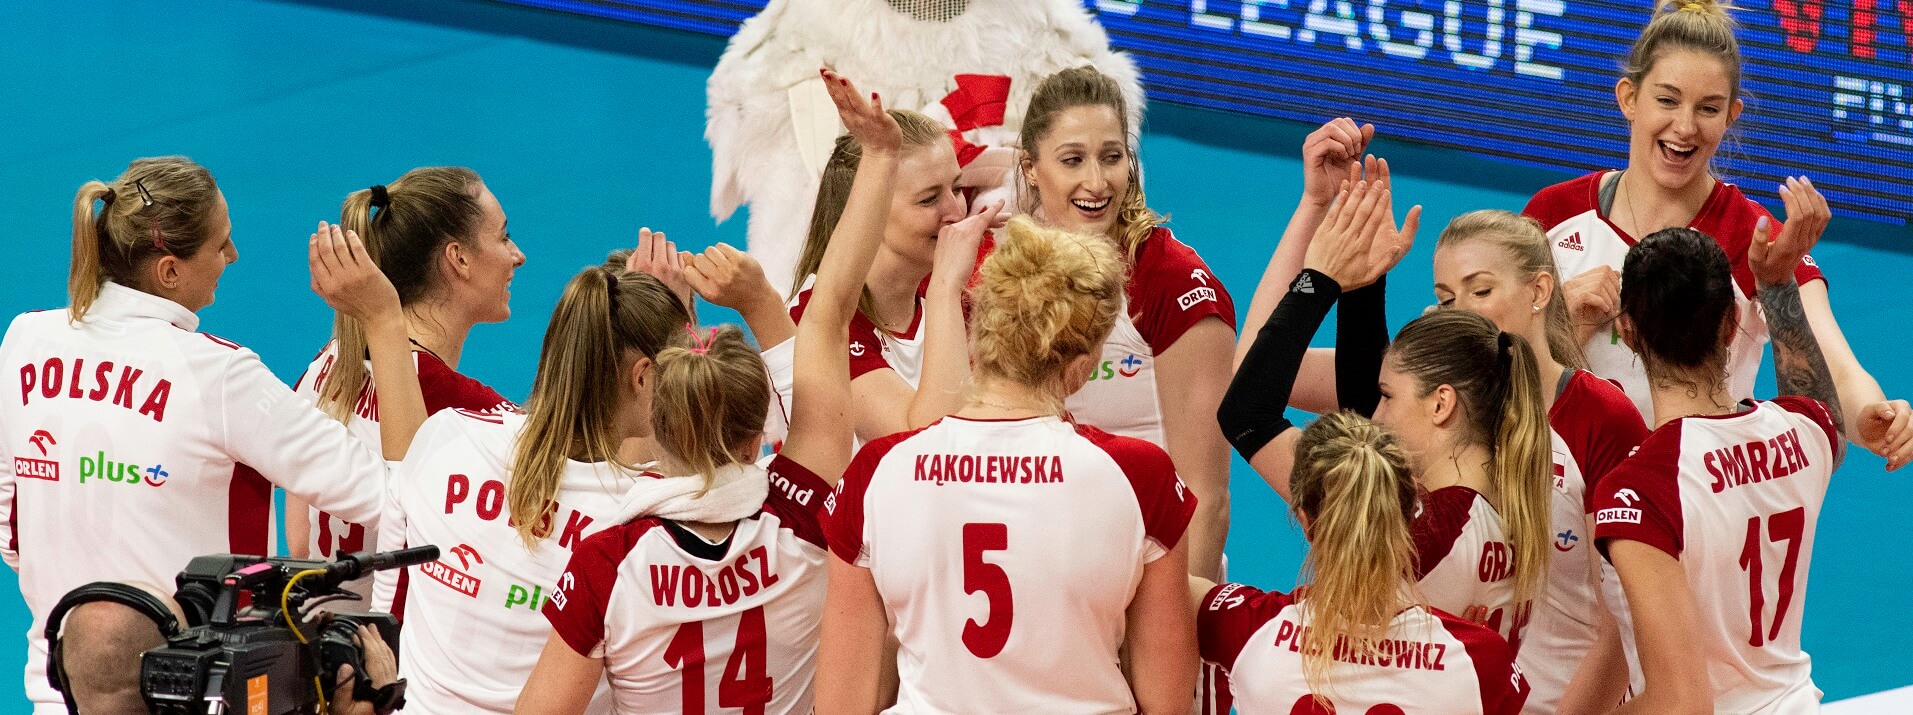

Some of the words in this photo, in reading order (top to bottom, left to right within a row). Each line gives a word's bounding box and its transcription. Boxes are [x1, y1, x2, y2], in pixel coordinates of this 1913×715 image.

[1558, 240, 1585, 252] adidas
[1181, 288, 1215, 307] ORLEN
[20, 357, 172, 423] POLSKA
[15, 459, 56, 479] ORLEN
[79, 450, 141, 484] plus
[914, 454, 1064, 486] KĄKOLEWSKA
[1703, 427, 1810, 494] SMARZEK
[769, 471, 815, 507] plus
[1598, 510, 1639, 521] ORLEN
[422, 561, 477, 596] ORLEN
[649, 544, 780, 609] WOŁOSZ
[961, 522, 1014, 659] 5
[1739, 506, 1805, 648] 17
[662, 604, 774, 715] 14
